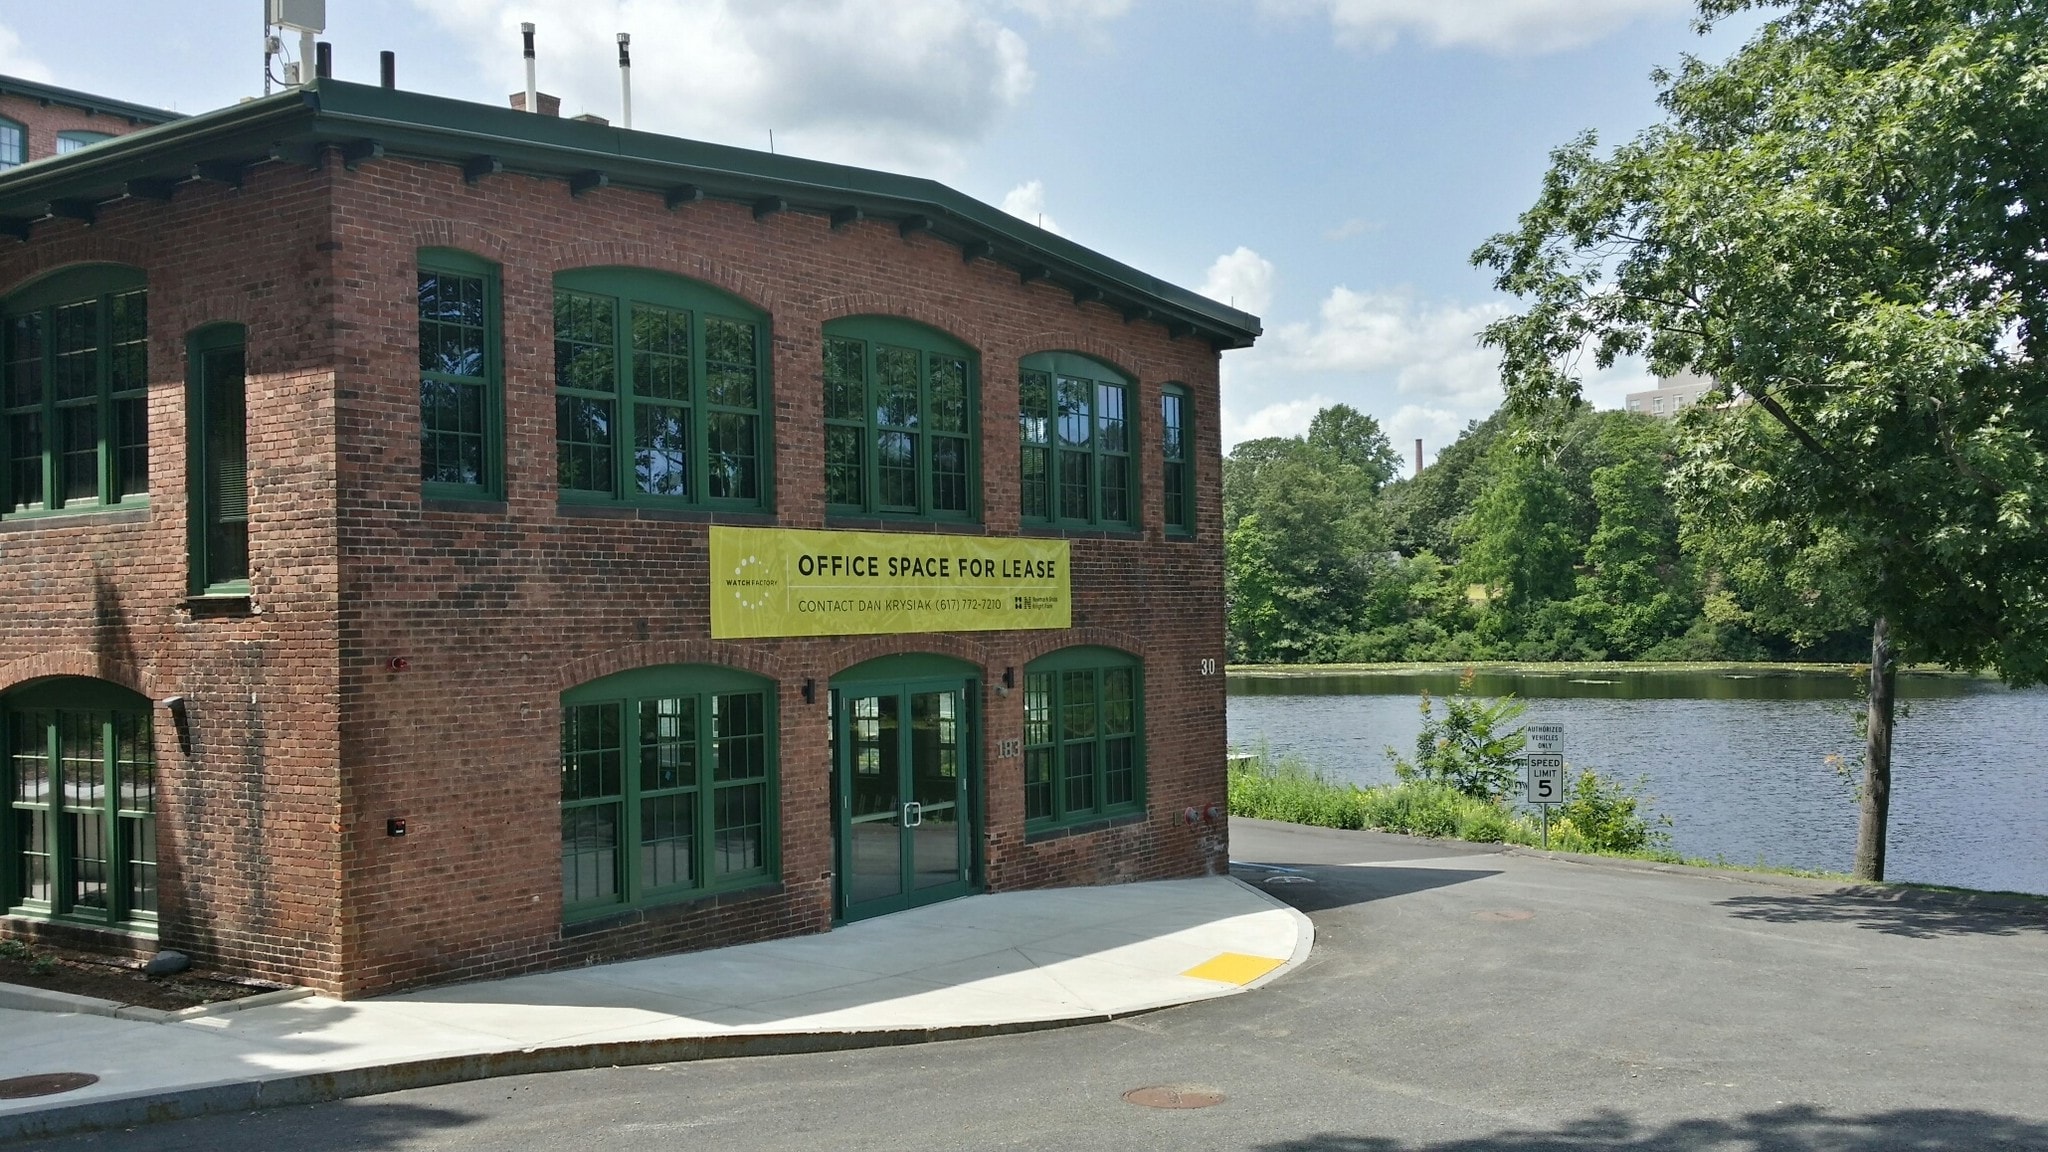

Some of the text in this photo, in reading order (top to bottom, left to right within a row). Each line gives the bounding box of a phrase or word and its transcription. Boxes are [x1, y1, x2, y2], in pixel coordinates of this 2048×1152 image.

[798, 554, 1055, 579] OFFICE SPACE FOR LEASE
[798, 599, 1002, 612] CONTACT DAN KRYSIAK (617) 772-7210
[1201, 658, 1215, 675] 30
[997, 739, 1021, 759] 183
[1531, 759, 1560, 767] SPEED
[1538, 780, 1552, 797] 5
